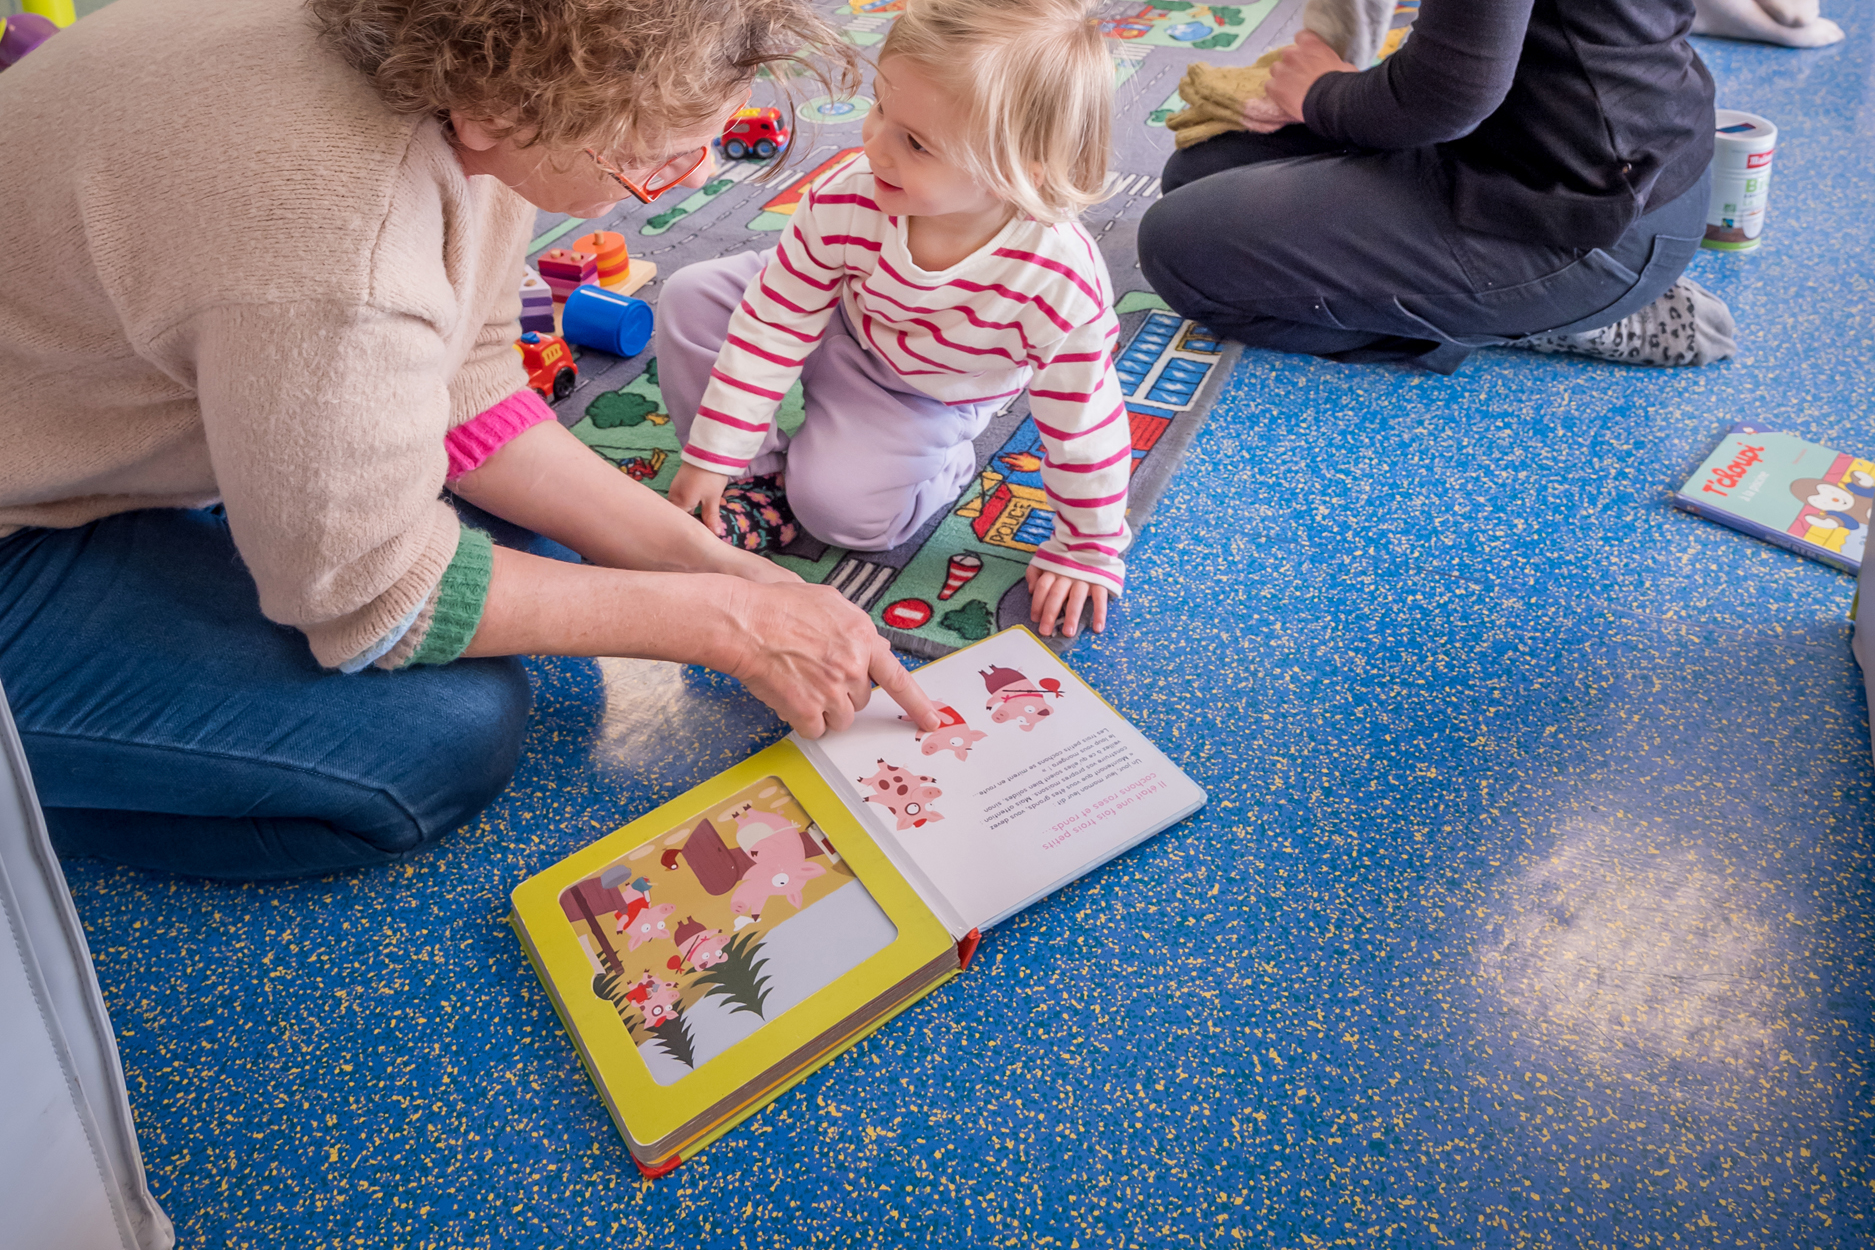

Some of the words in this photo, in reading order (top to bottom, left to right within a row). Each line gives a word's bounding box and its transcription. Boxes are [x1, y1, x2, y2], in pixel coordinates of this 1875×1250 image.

[1702, 441, 1765, 497] T'choupi
[989, 501, 1031, 544] POLICE
[1096, 727, 1109, 735] Les
[1081, 733, 1097, 742] trois
[1093, 736, 1109, 745] loup
[1062, 740, 1081, 752] petits
[1079, 744, 1094, 753] vous
[1101, 739, 1121, 751] veillez
[1036, 750, 1063, 765] cochons
[1051, 751, 1079, 767] mangera
[1096, 745, 1127, 763] construire
[1085, 761, 1097, 769] vos
[1093, 754, 1129, 776] Maintenant
[1006, 768, 1028, 782] mirent
[1043, 769, 1063, 782] soient
[1060, 766, 1085, 782] propres
[1080, 773, 1093, 781] que
[1104, 770, 1118, 779] leur
[1027, 779, 1044, 789] bien
[1065, 780, 1081, 789] vous
[1079, 777, 1104, 792] maman
[1118, 772, 1156, 794] cochons
[1157, 780, 1167, 788] Il
[1050, 787, 1066, 797] êtes
[1066, 790, 1081, 799] leur
[1134, 784, 1157, 800] était
[983, 800, 1002, 812] sinon
[1014, 795, 1032, 806] Mais
[1056, 797, 1066, 805] dit
[1092, 792, 1118, 809] roses
[1115, 797, 1134, 809] une
[983, 804, 1014, 822] attention
[1009, 809, 1025, 819] vous
[1080, 807, 1091, 817] et
[1095, 807, 1116, 820] fois
[989, 817, 1009, 830] devez
[1072, 818, 1096, 833] trois
[1041, 829, 1071, 850] petits
